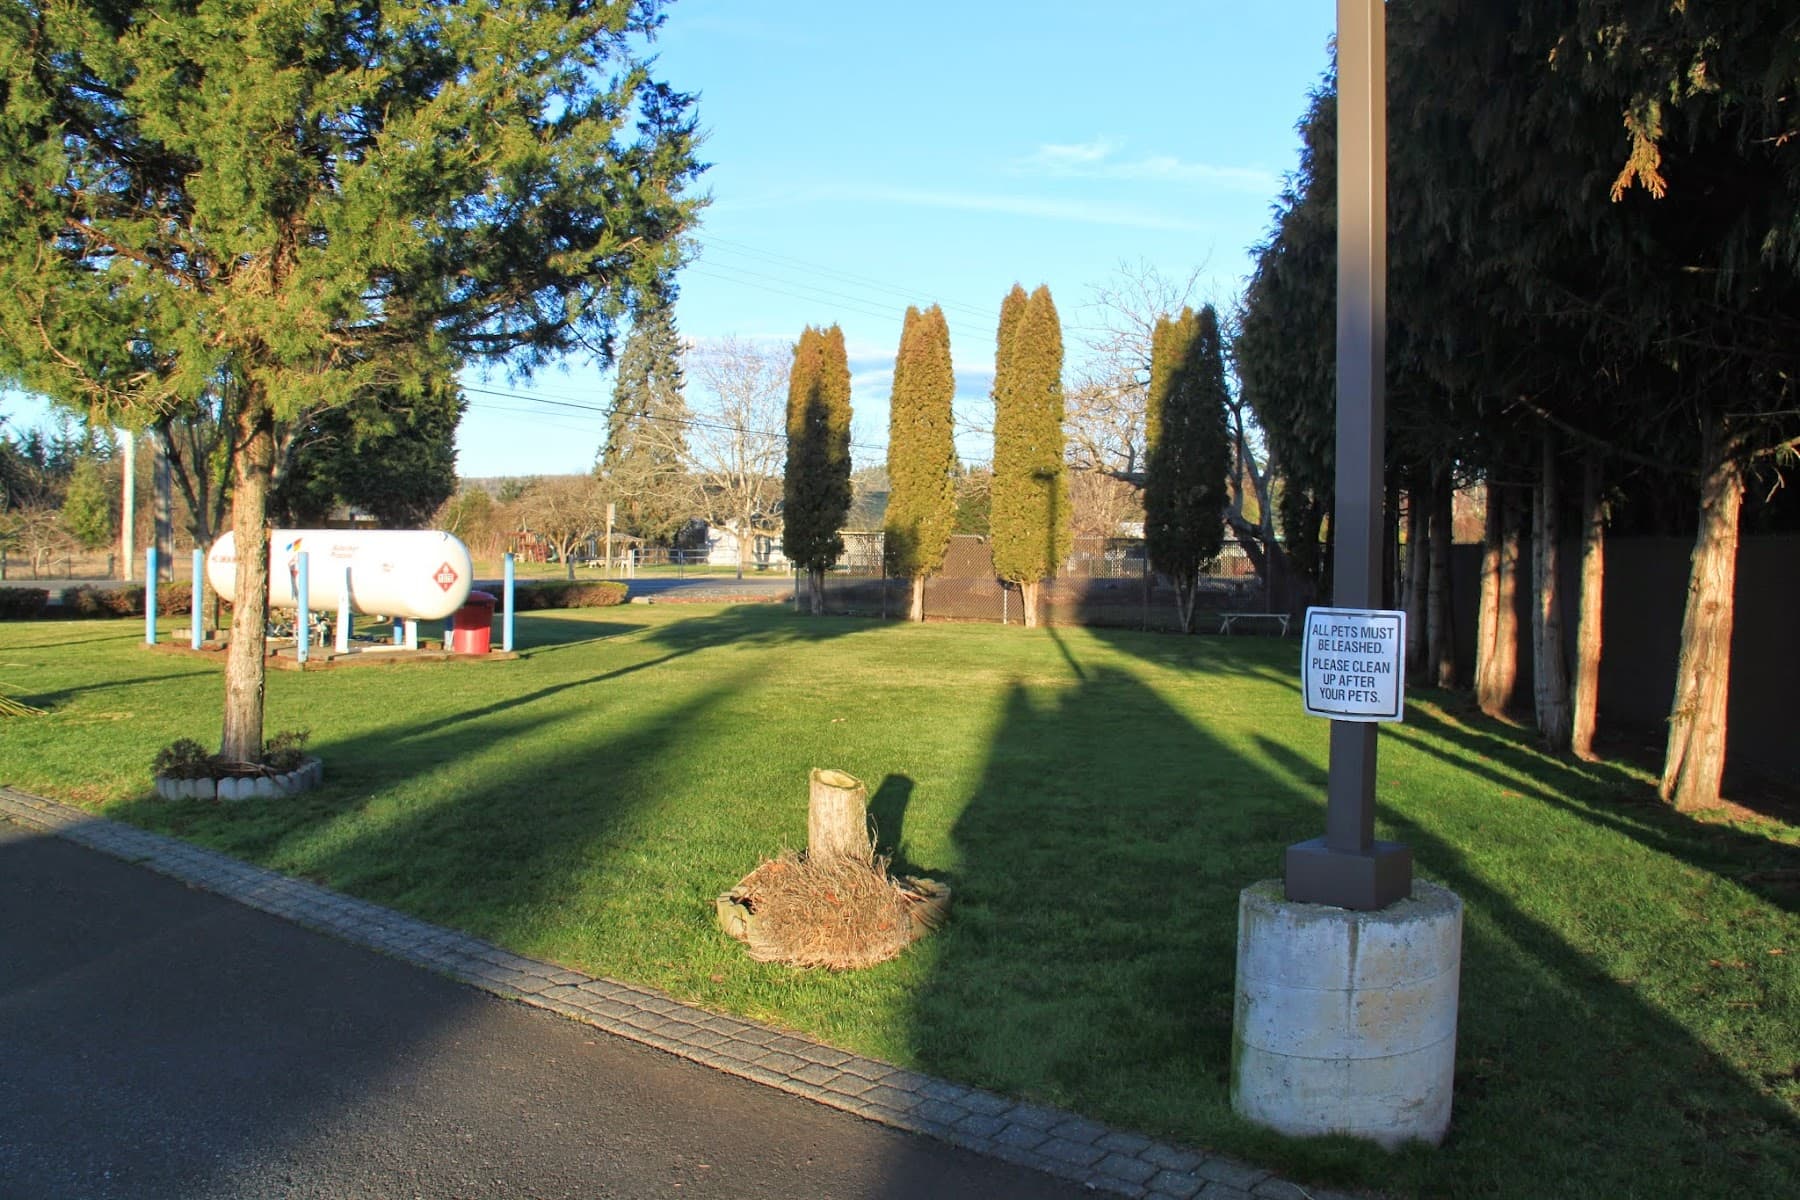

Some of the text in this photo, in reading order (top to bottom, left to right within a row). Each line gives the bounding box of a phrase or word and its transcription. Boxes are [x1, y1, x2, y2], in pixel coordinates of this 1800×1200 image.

[1312, 624, 1394, 640] ALL PETS MUST
[1318, 639, 1384, 654] BE LEASHED.
[1312, 658, 1390, 674] PLEASE CLEAN
[1324, 674, 1374, 688] UP AFTER
[1320, 688, 1380, 702] YOUR PETS.
